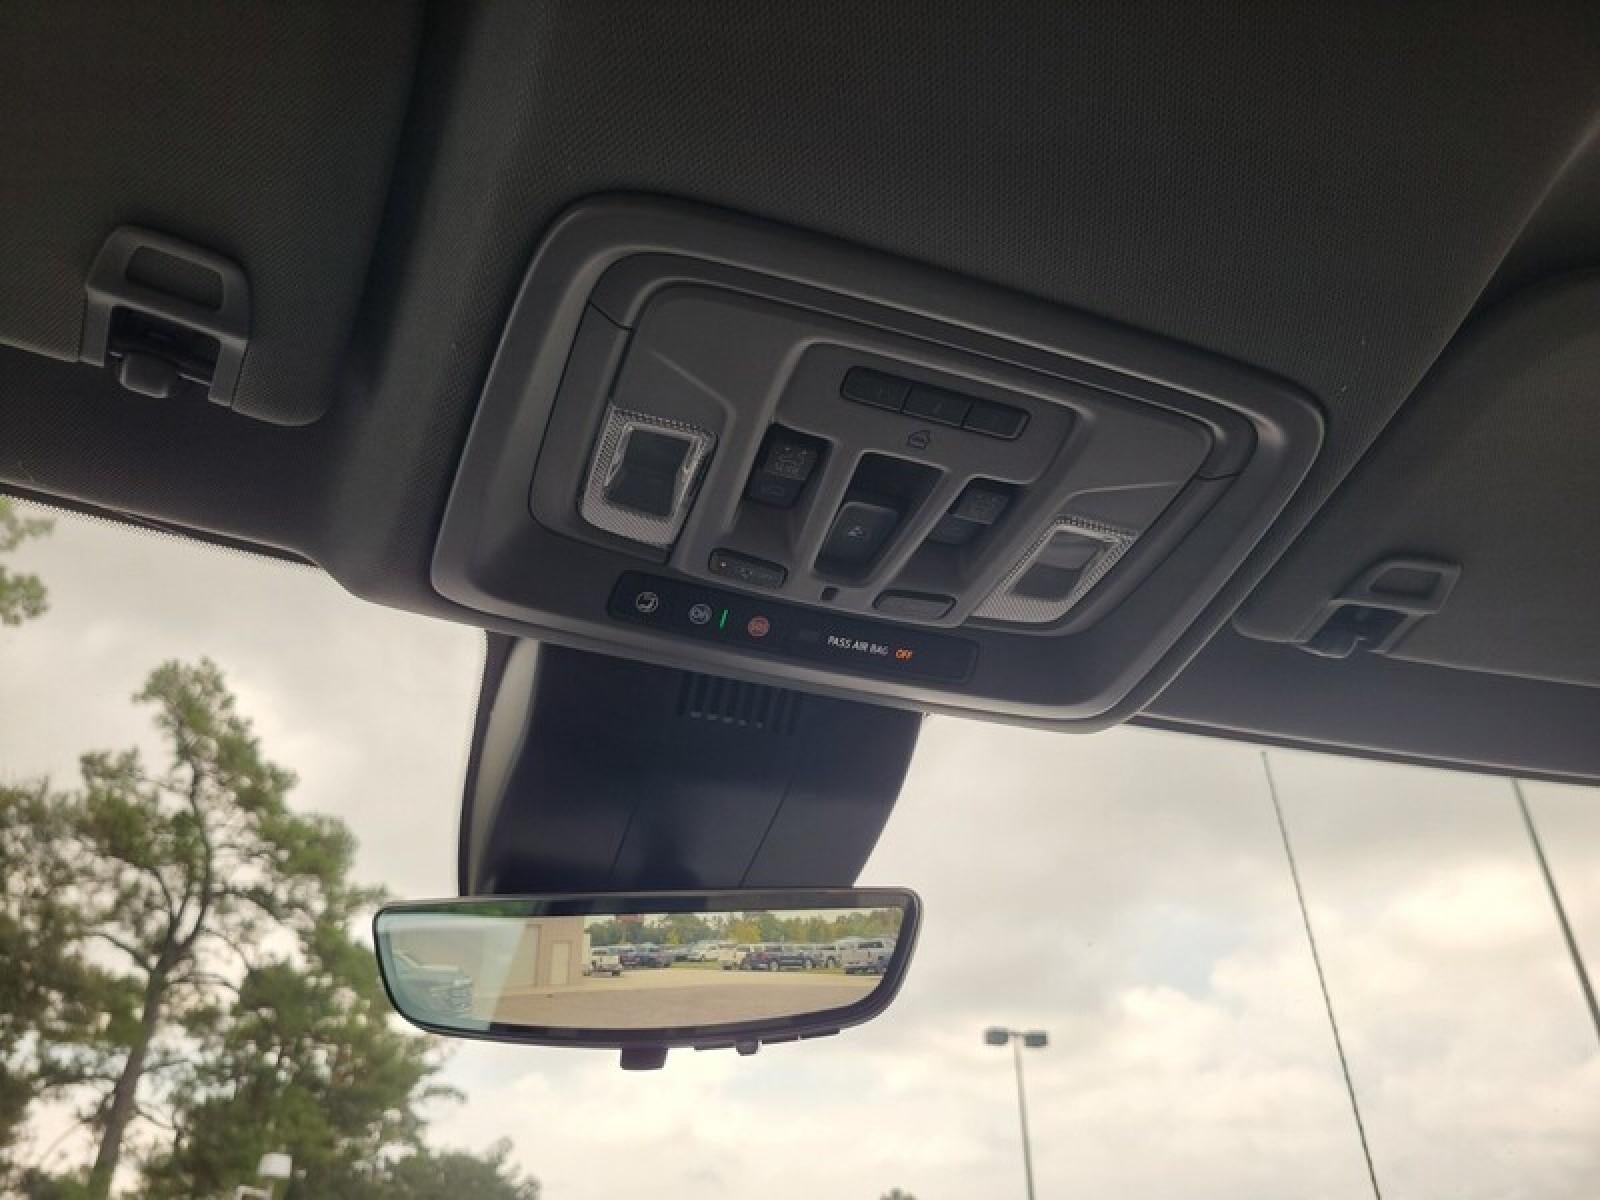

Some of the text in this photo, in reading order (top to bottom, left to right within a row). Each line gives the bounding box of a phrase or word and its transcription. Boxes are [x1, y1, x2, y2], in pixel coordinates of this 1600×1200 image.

[827, 635, 913, 660] PASS AIR BAG OFF
